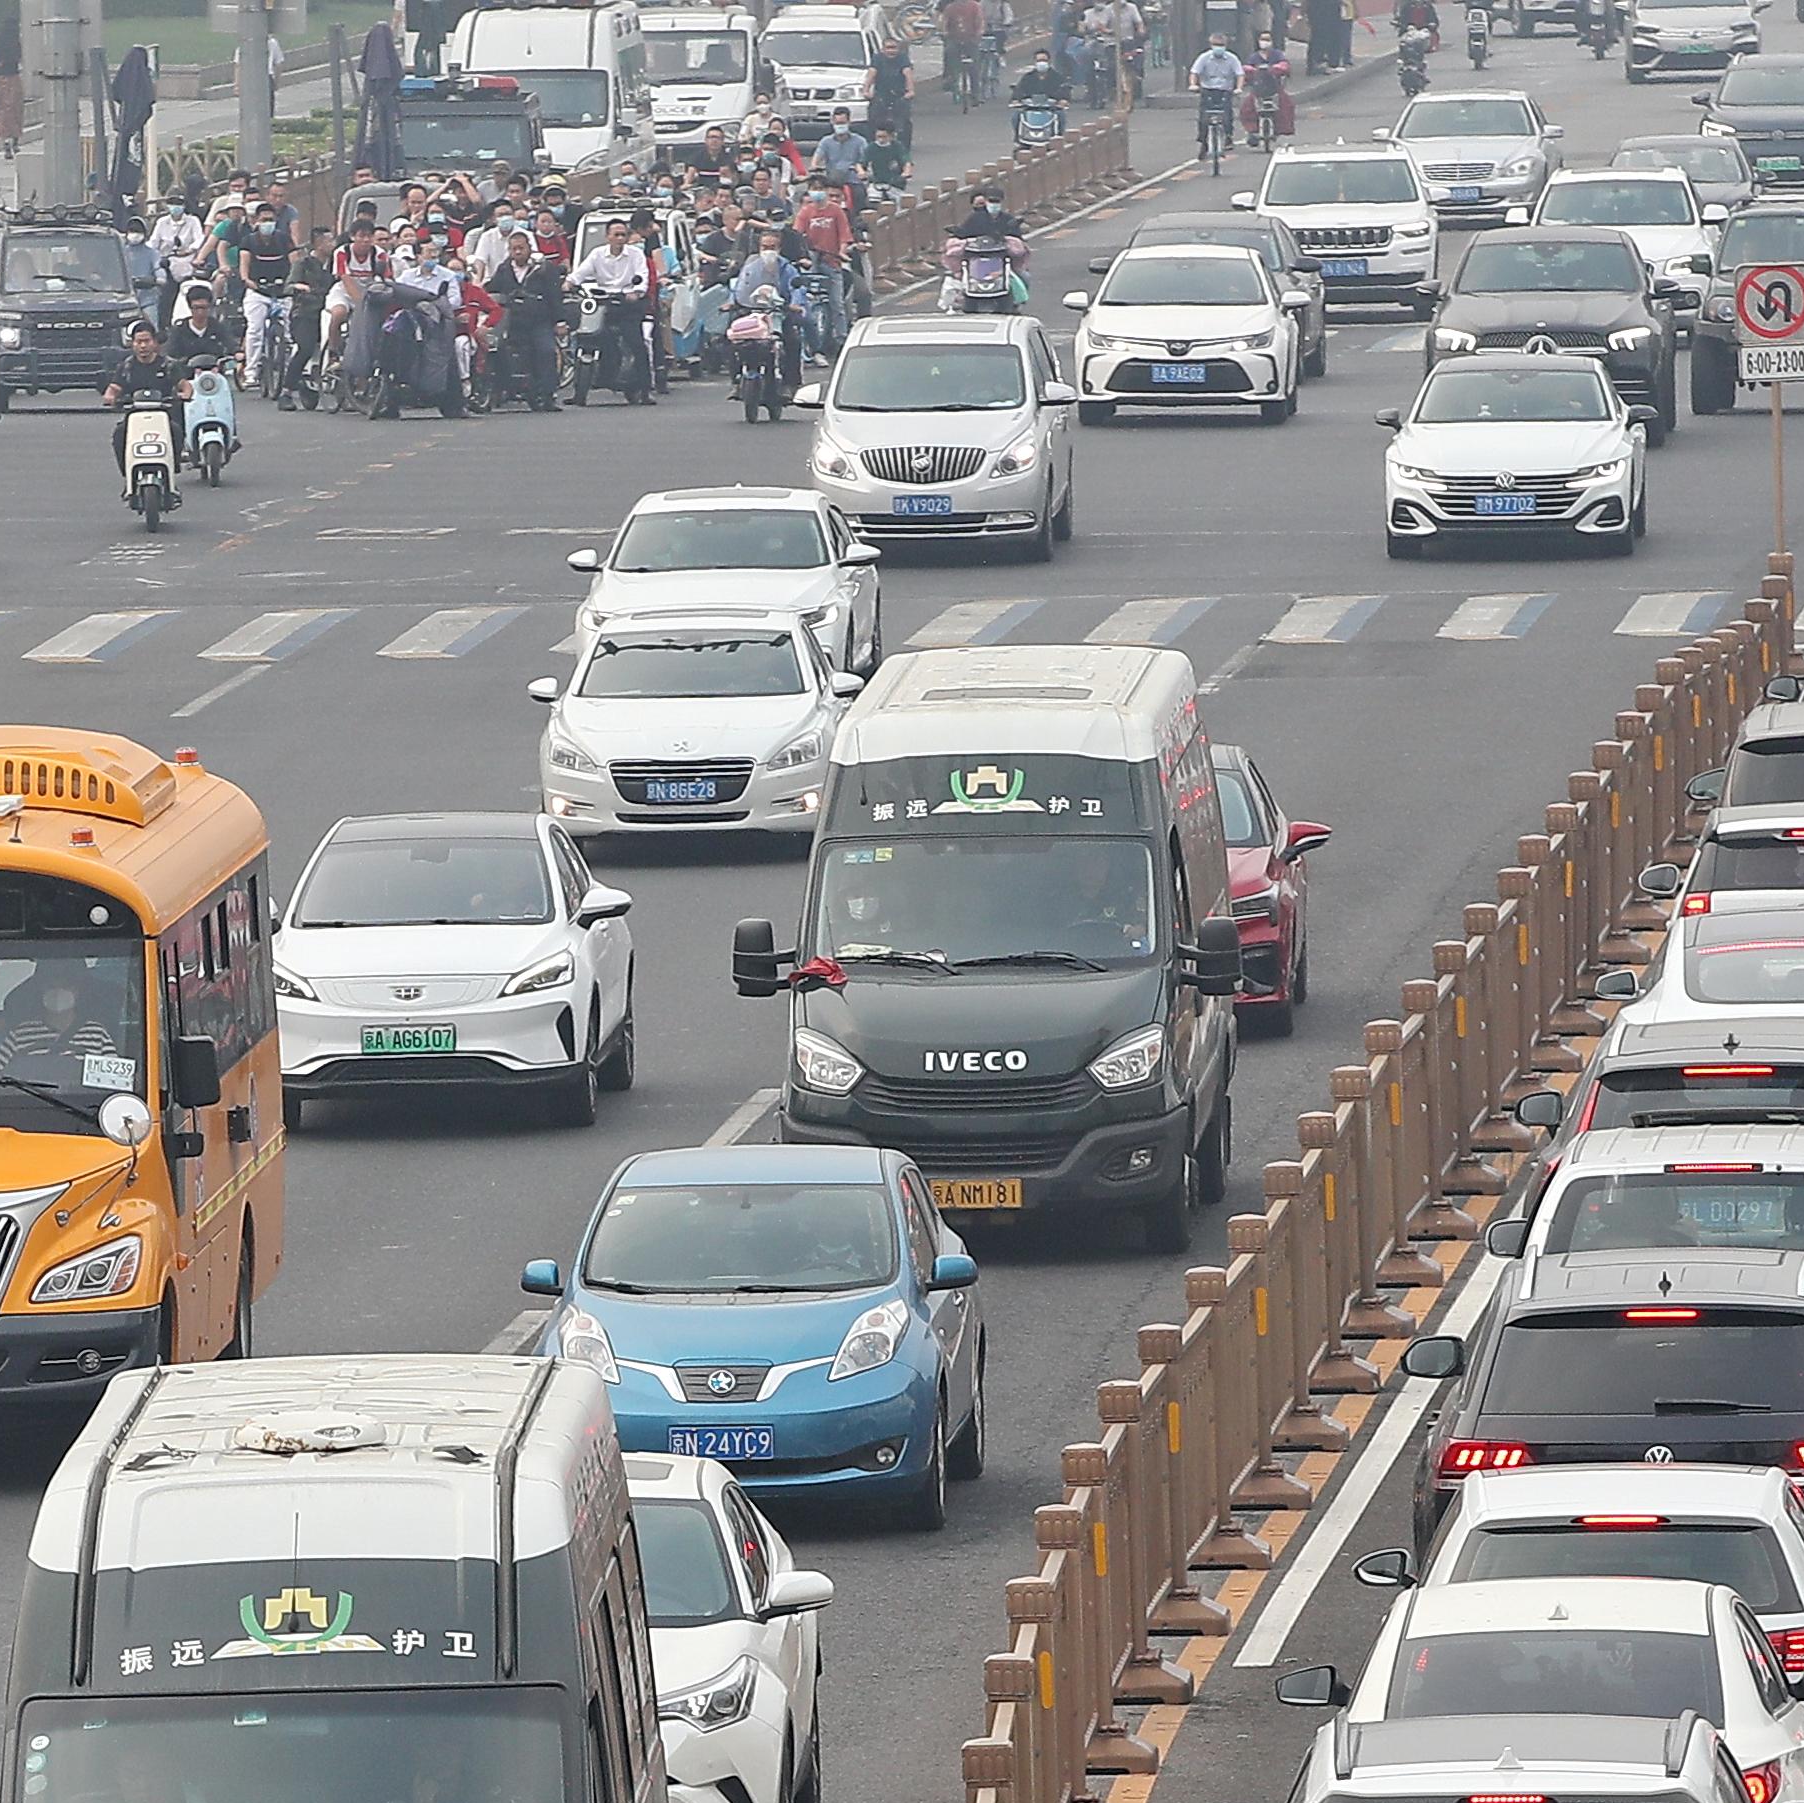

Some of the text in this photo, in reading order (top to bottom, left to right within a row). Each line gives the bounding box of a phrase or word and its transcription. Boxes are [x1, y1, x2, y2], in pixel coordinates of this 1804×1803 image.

[1747, 350, 1804, 374] 6:00-23:00
[873, 797, 1104, 821] 振远 护卫
[924, 1050, 1027, 1071] IVECO
[119, 1626, 478, 1676] 振远 护卫
